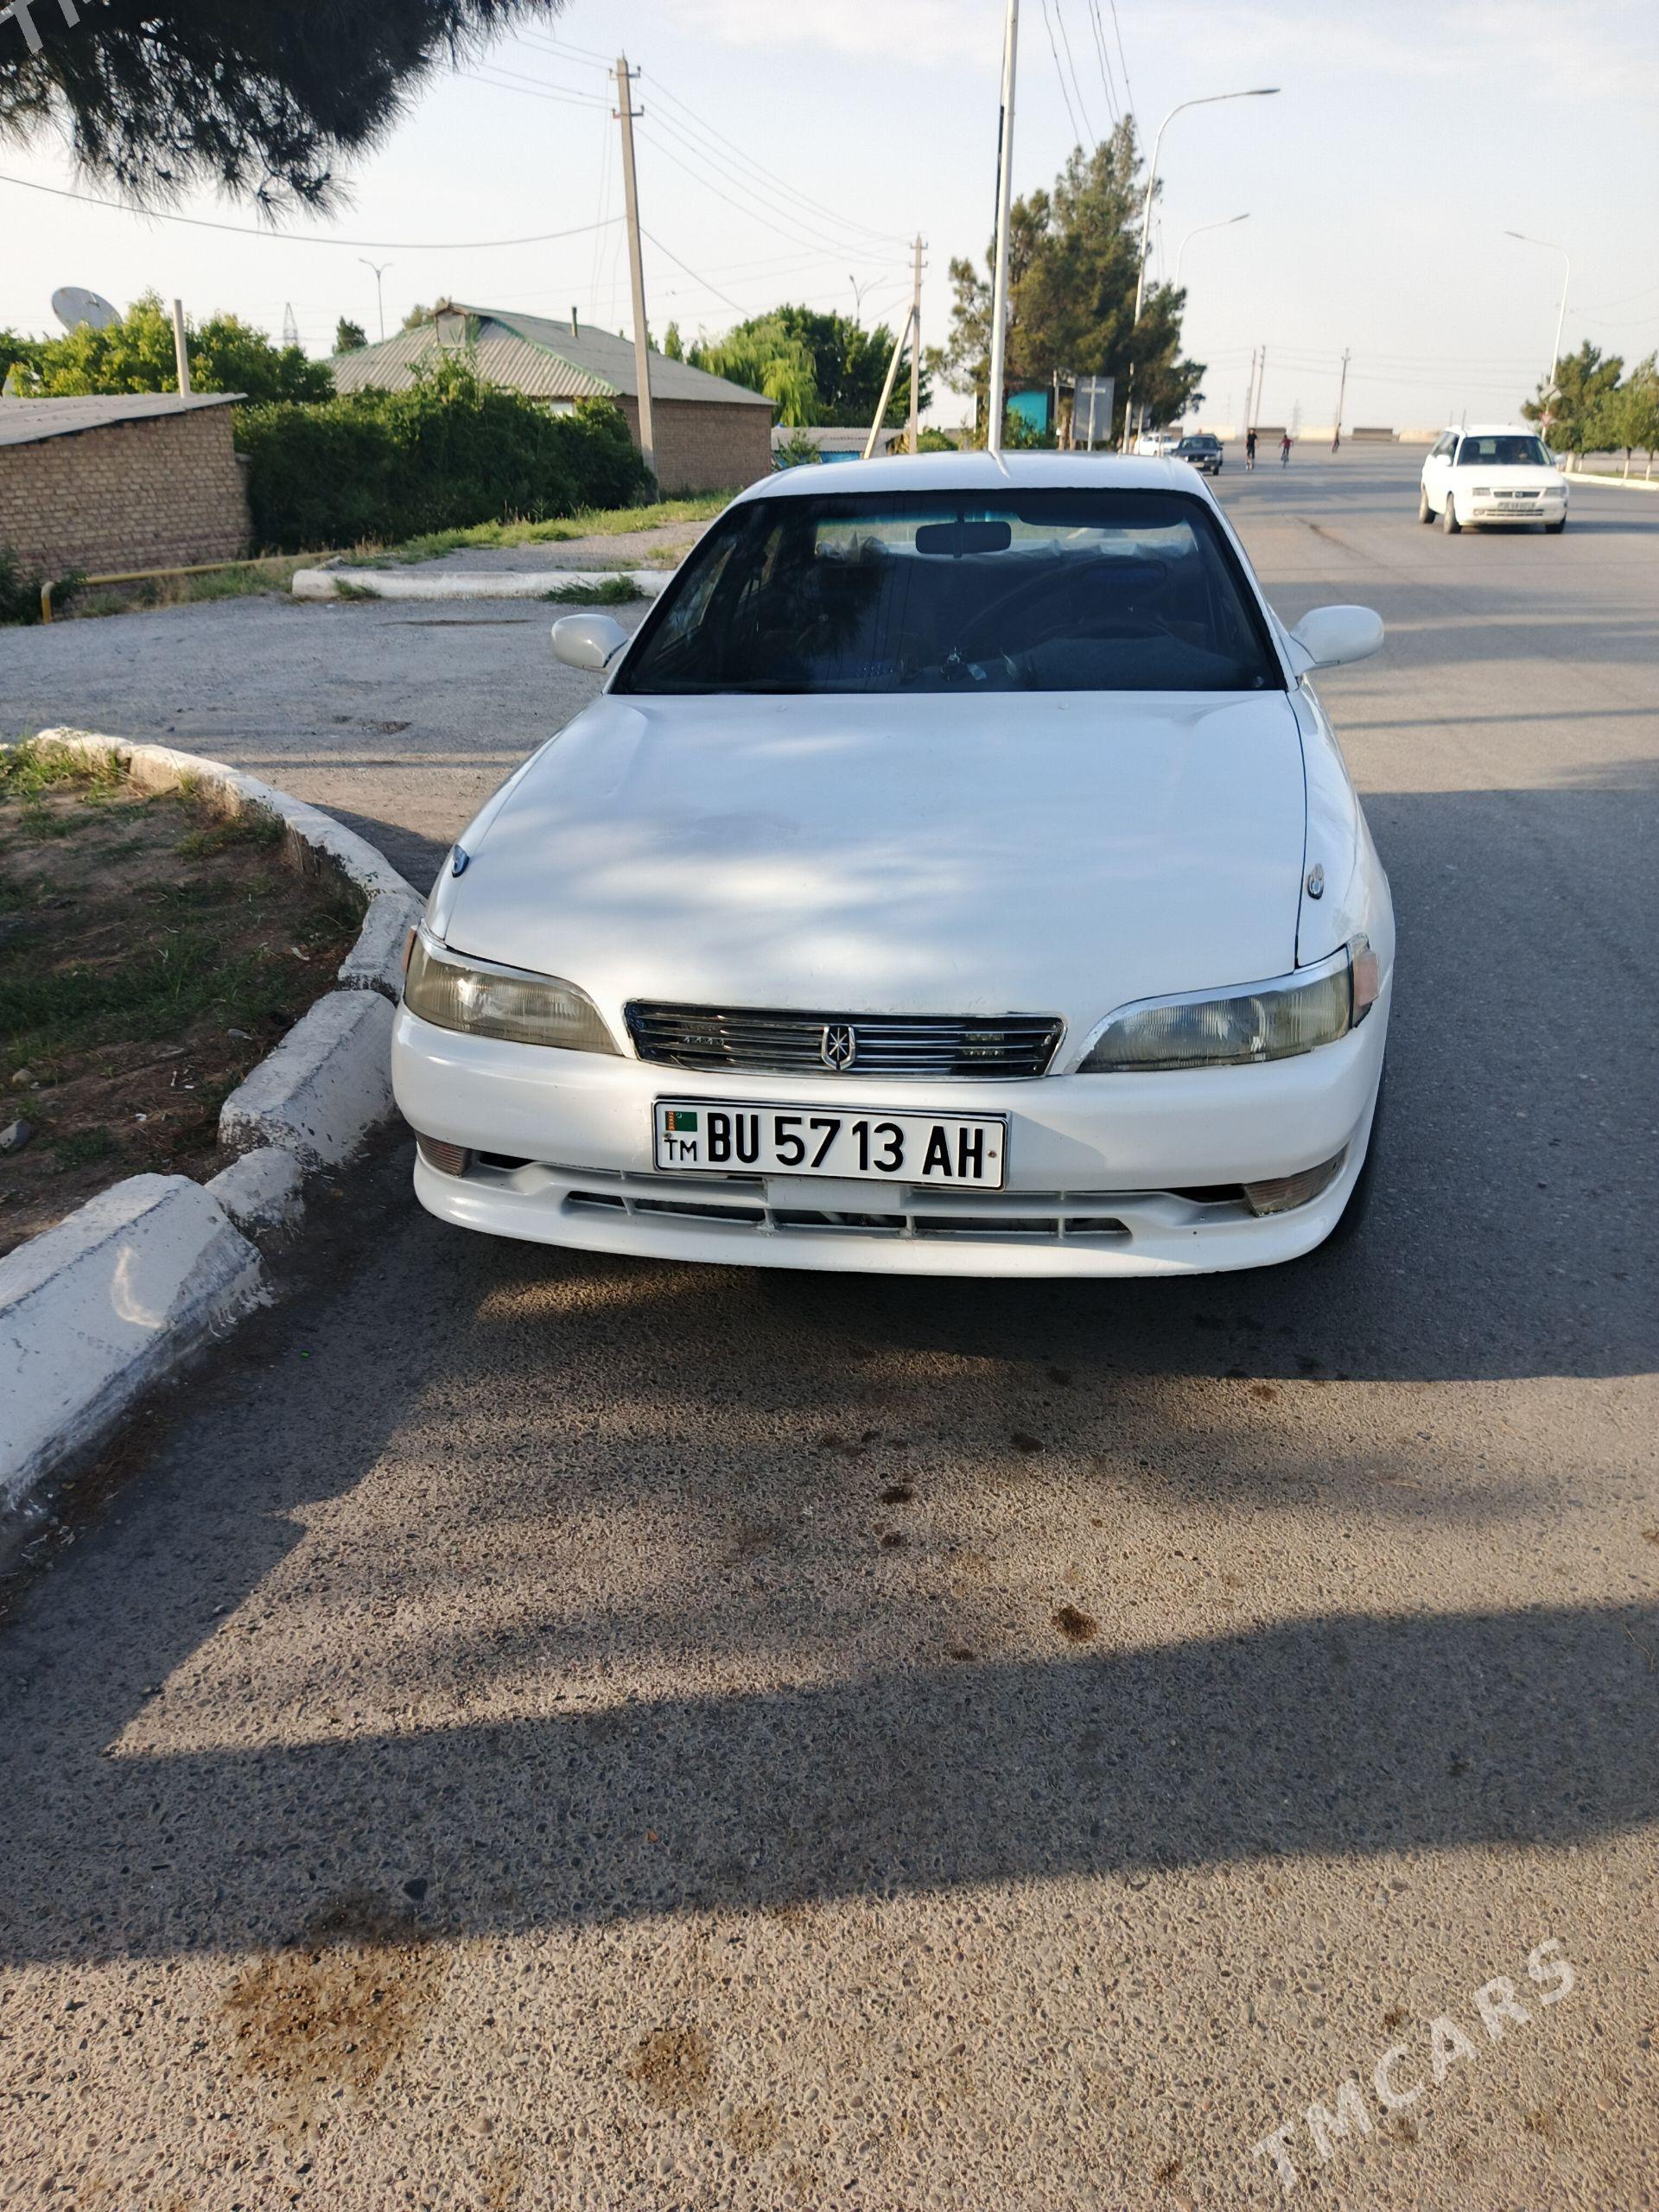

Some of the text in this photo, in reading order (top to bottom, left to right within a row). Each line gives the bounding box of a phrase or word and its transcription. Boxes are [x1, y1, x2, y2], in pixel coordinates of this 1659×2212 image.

[664, 1138, 697, 1162] TM
[707, 1111, 760, 1164] BU
[922, 1125, 983, 1179] AH
